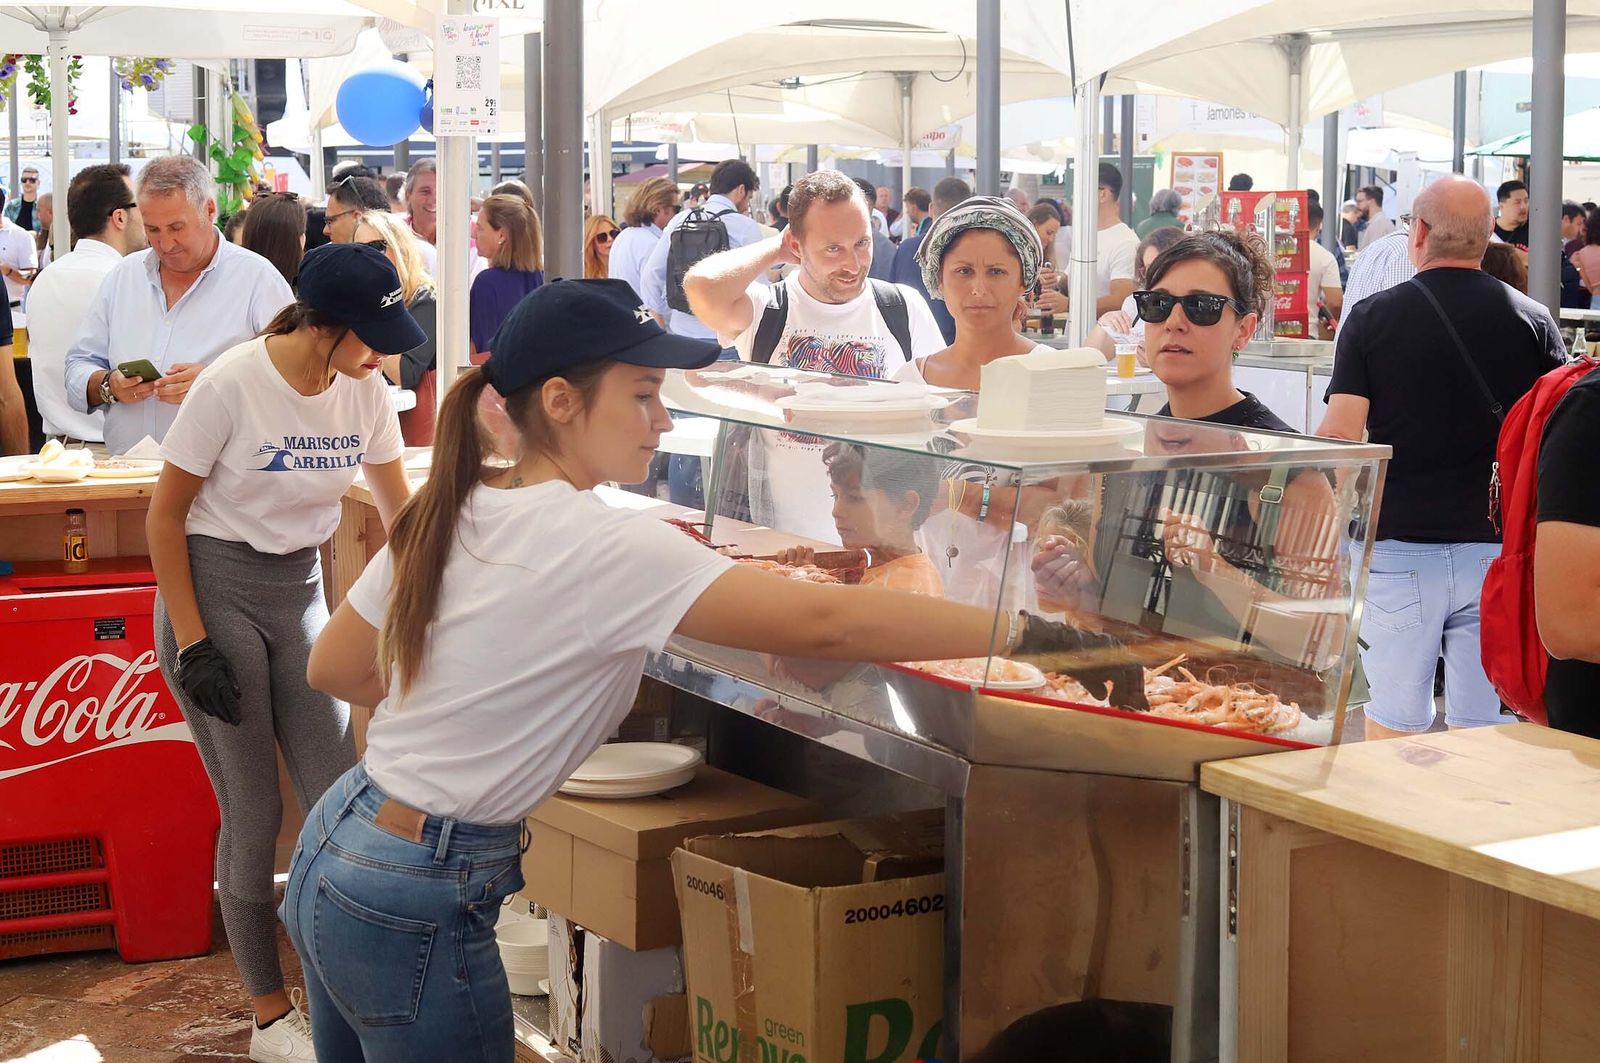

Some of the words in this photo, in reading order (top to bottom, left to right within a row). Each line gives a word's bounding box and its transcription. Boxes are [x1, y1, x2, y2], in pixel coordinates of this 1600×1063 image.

[1207, 104, 1246, 121] Jamones
[283, 434, 361, 451] MARISCOS
[686, 874, 727, 901] 200046
[844, 893, 945, 925] 20004602
[764, 1018, 805, 1049] green
